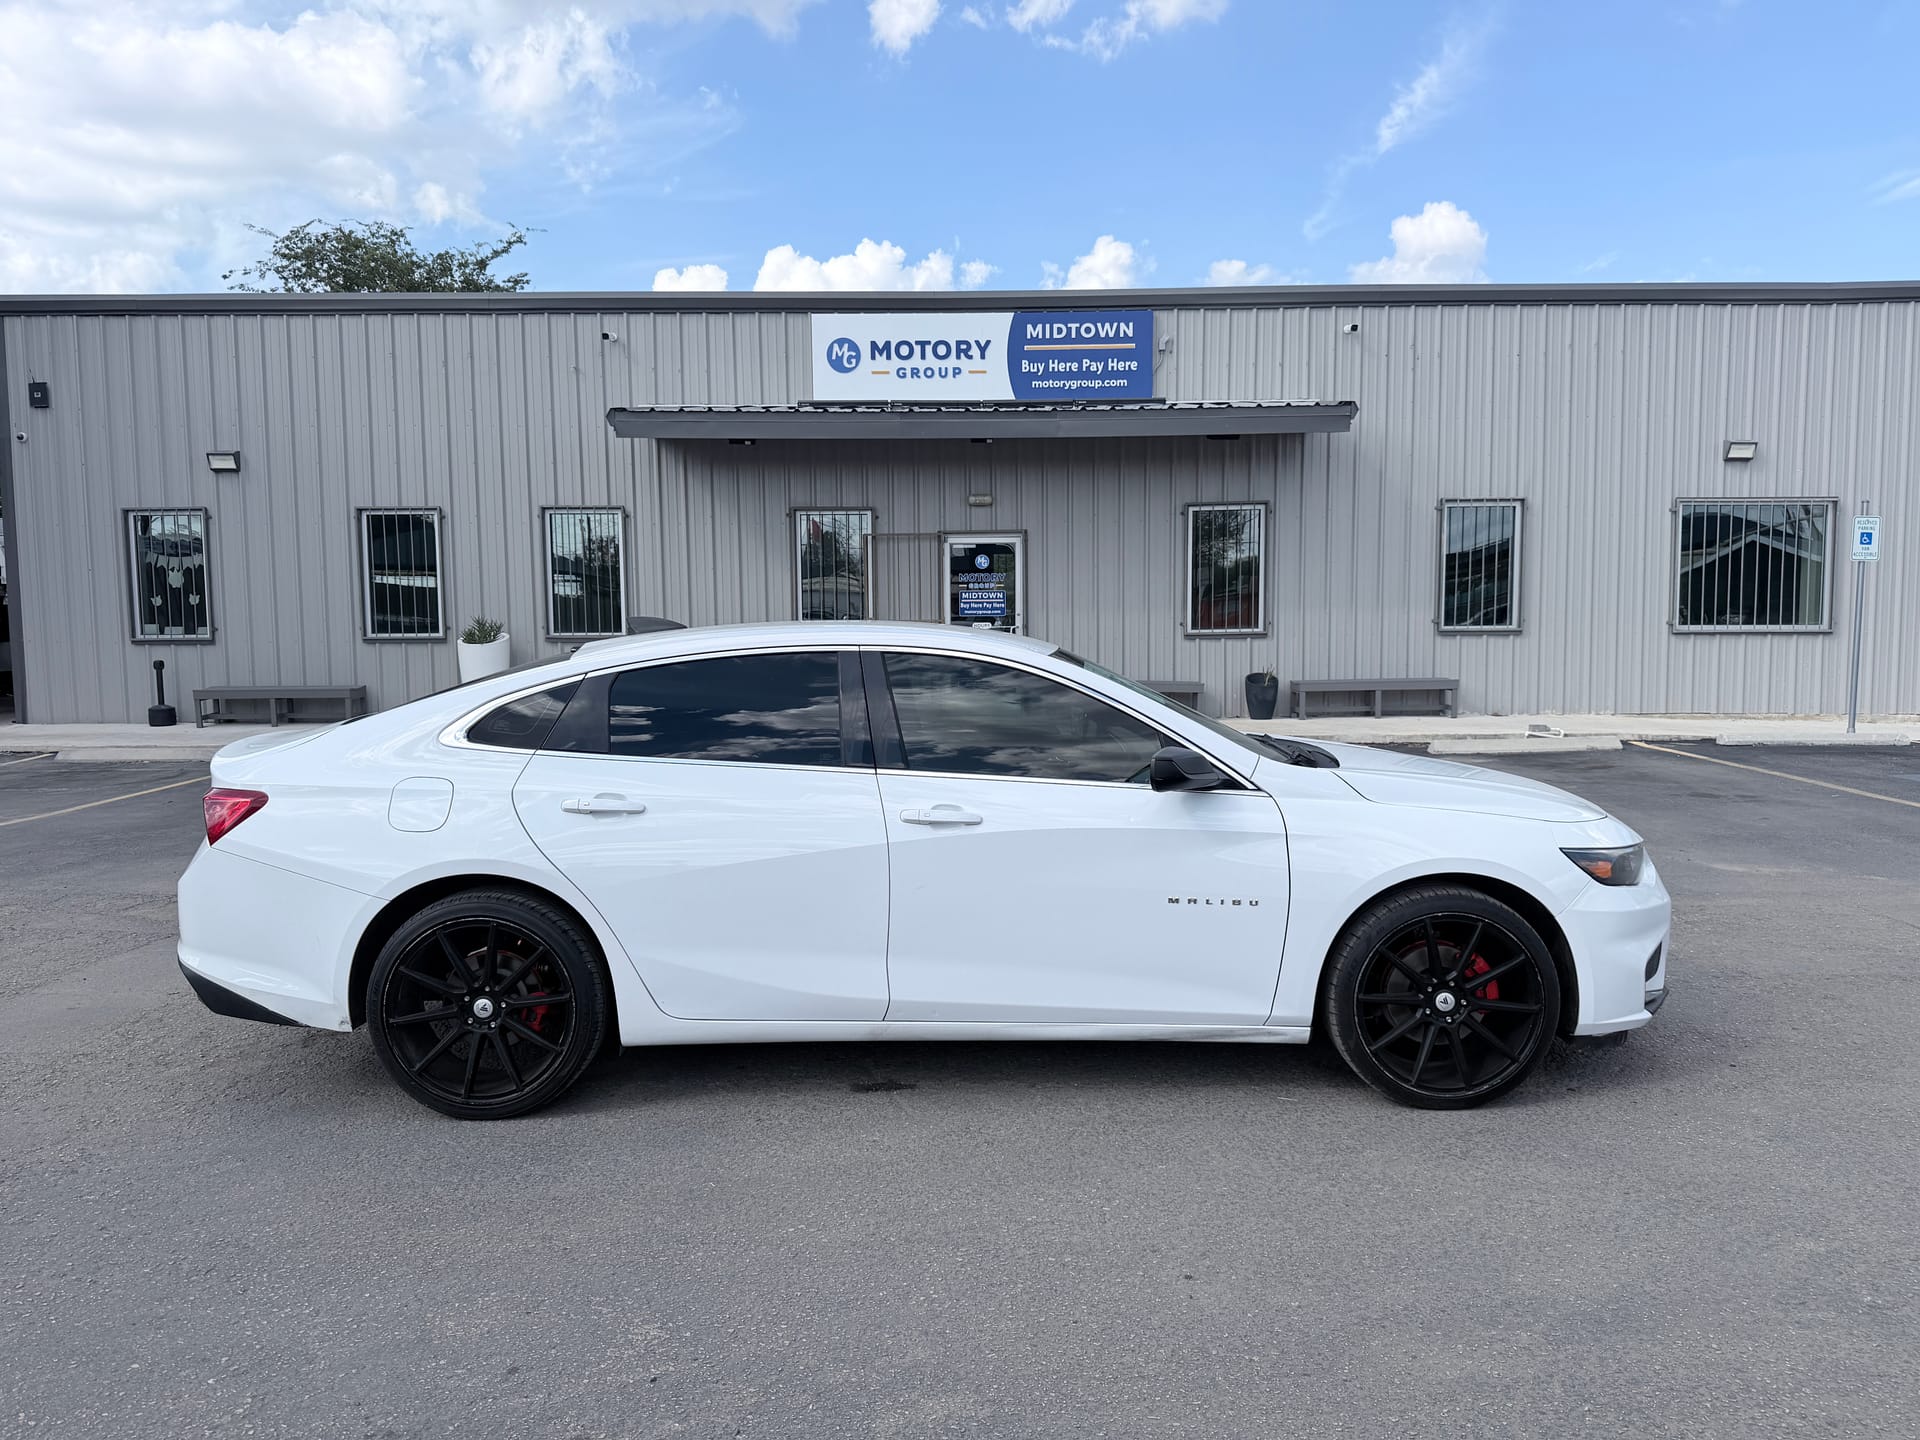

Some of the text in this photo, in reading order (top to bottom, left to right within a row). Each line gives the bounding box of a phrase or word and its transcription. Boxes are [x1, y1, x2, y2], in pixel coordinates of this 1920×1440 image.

[1026, 322, 1134, 339] MIDTOWN
[831, 342, 857, 369] MG
[870, 339, 992, 361] MOTORY
[896, 366, 962, 379] GROUP
[1021, 358, 1138, 375] Buy Here Pay Here
[1031, 379, 1128, 390] motorygroup.com
[959, 573, 1006, 582] MOTORY
[1167, 897, 1259, 906] MALIBU
